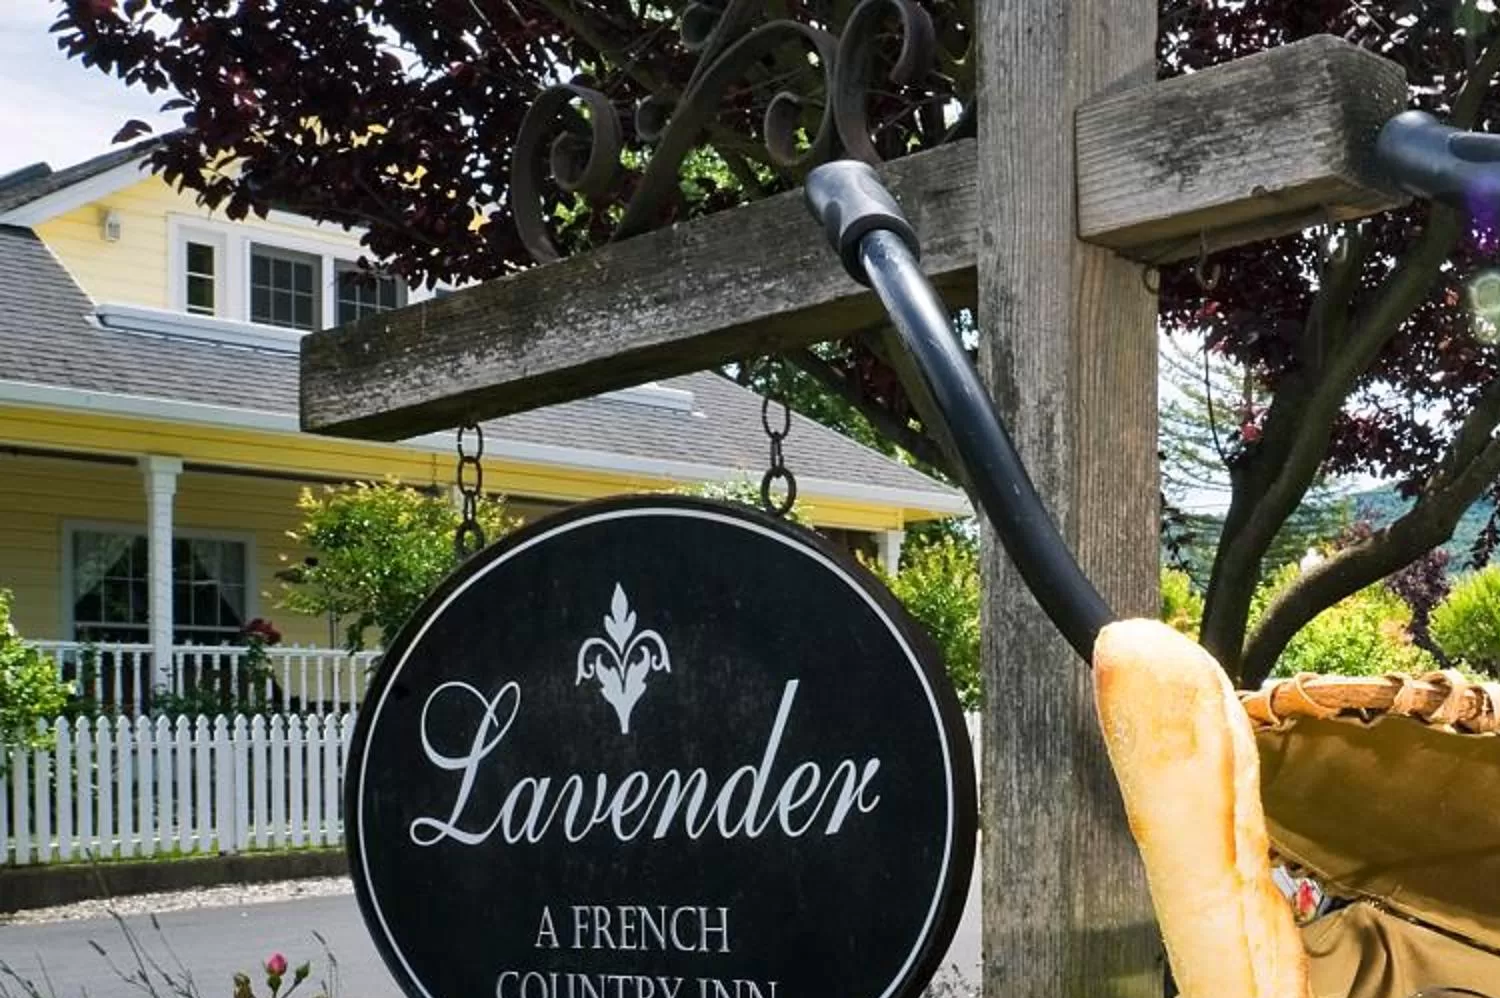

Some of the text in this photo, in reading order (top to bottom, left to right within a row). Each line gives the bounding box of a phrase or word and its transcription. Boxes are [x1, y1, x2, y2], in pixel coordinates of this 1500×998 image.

[410, 679, 881, 846] Lavender
[535, 906, 729, 952] A FRENCH
